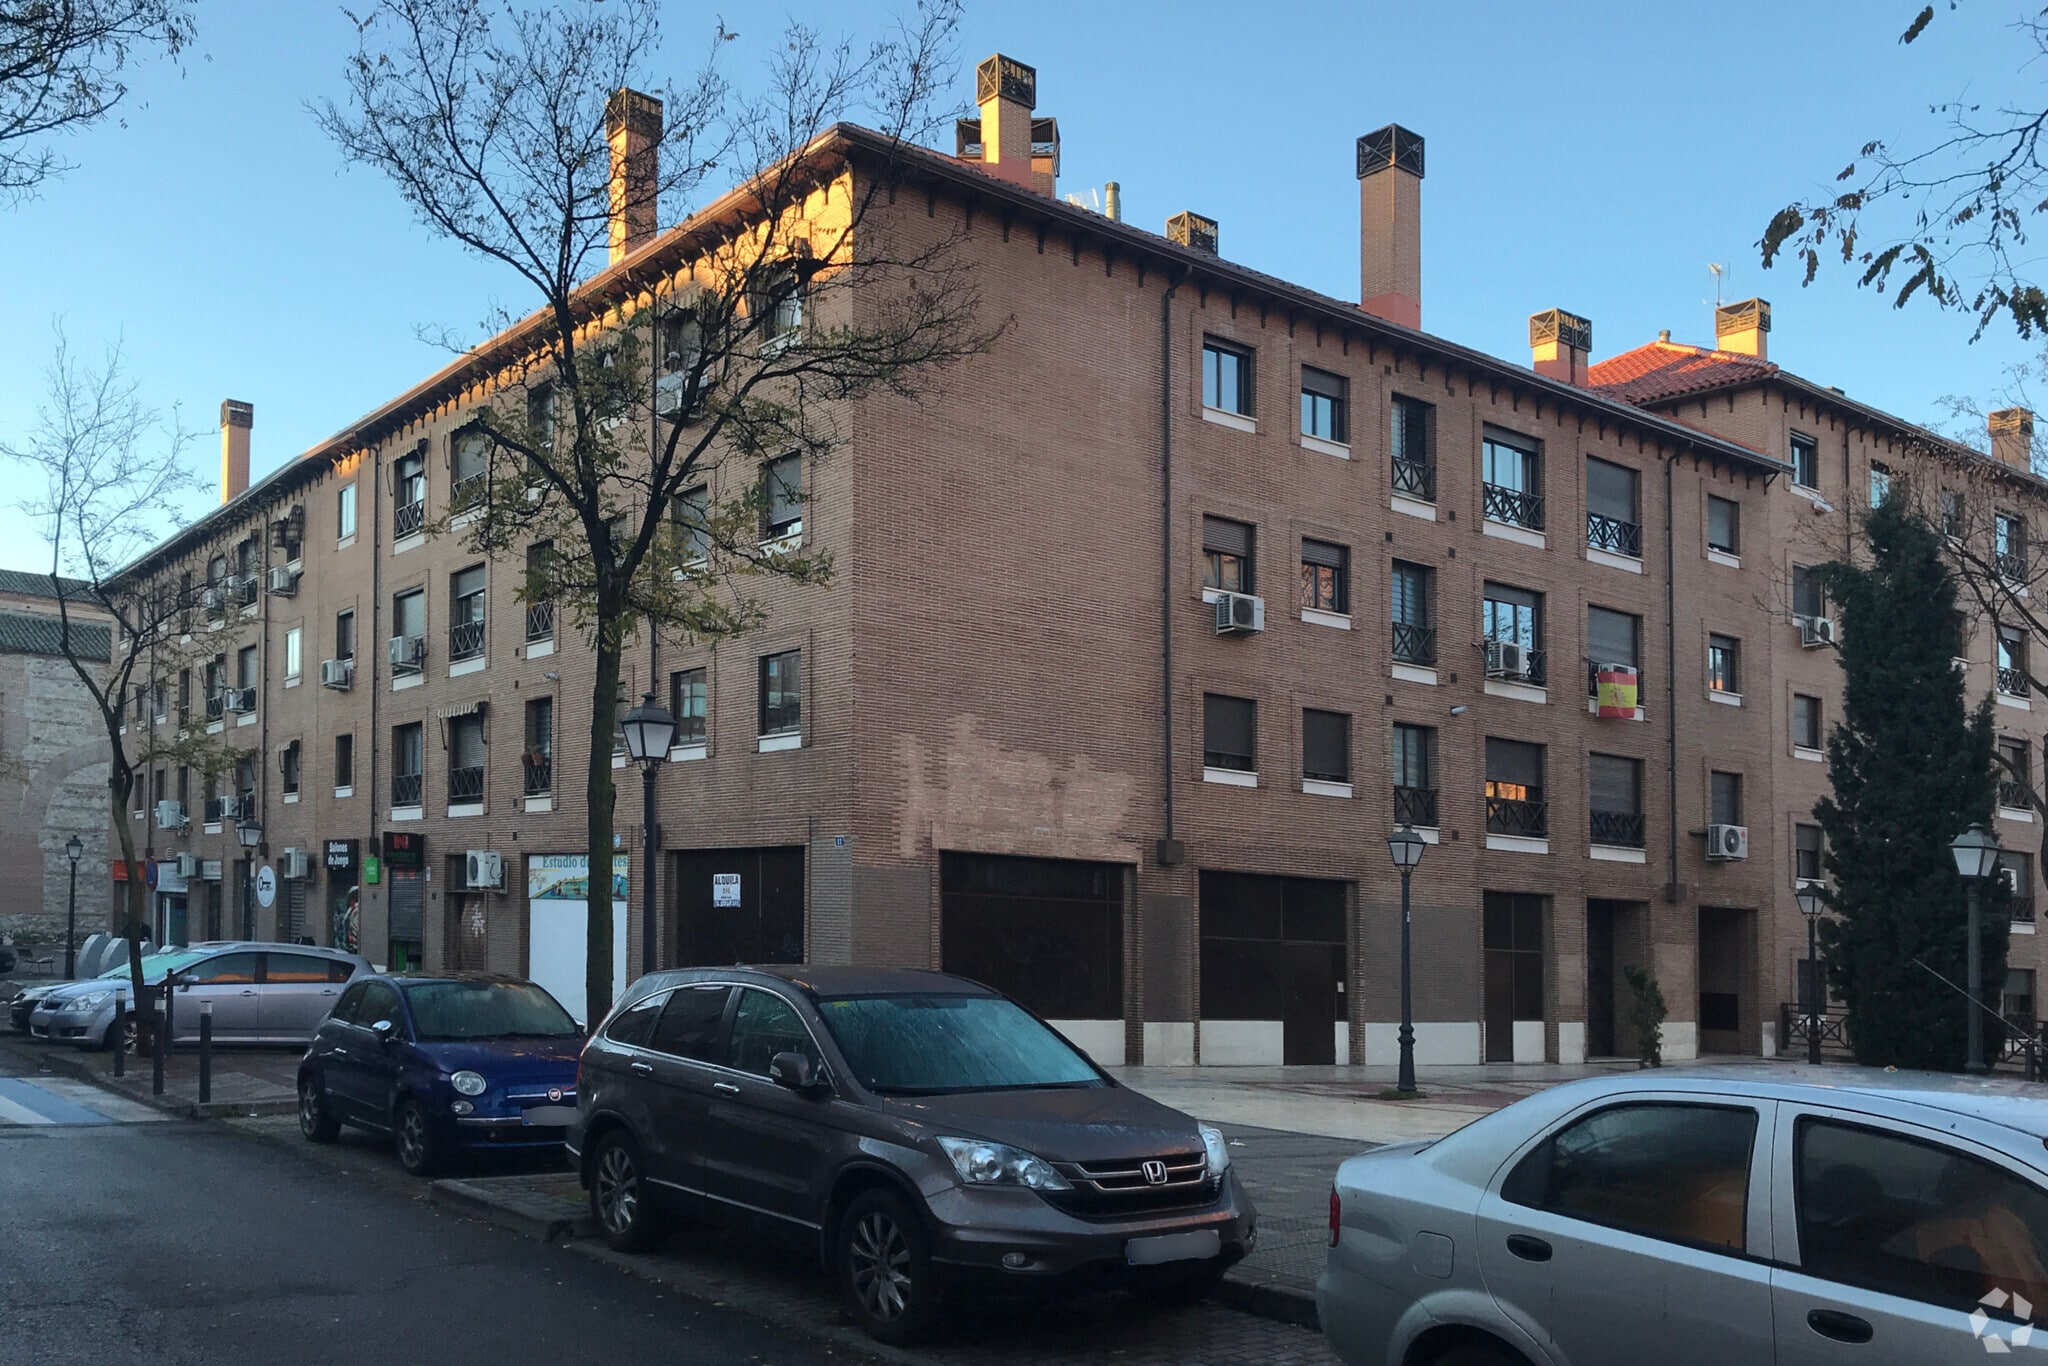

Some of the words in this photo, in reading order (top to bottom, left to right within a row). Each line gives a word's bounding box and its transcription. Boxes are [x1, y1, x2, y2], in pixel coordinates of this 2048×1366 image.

[543, 854, 577, 868] Estudio
[580, 855, 589, 868] d
[715, 875, 739, 885] ALQUILA
